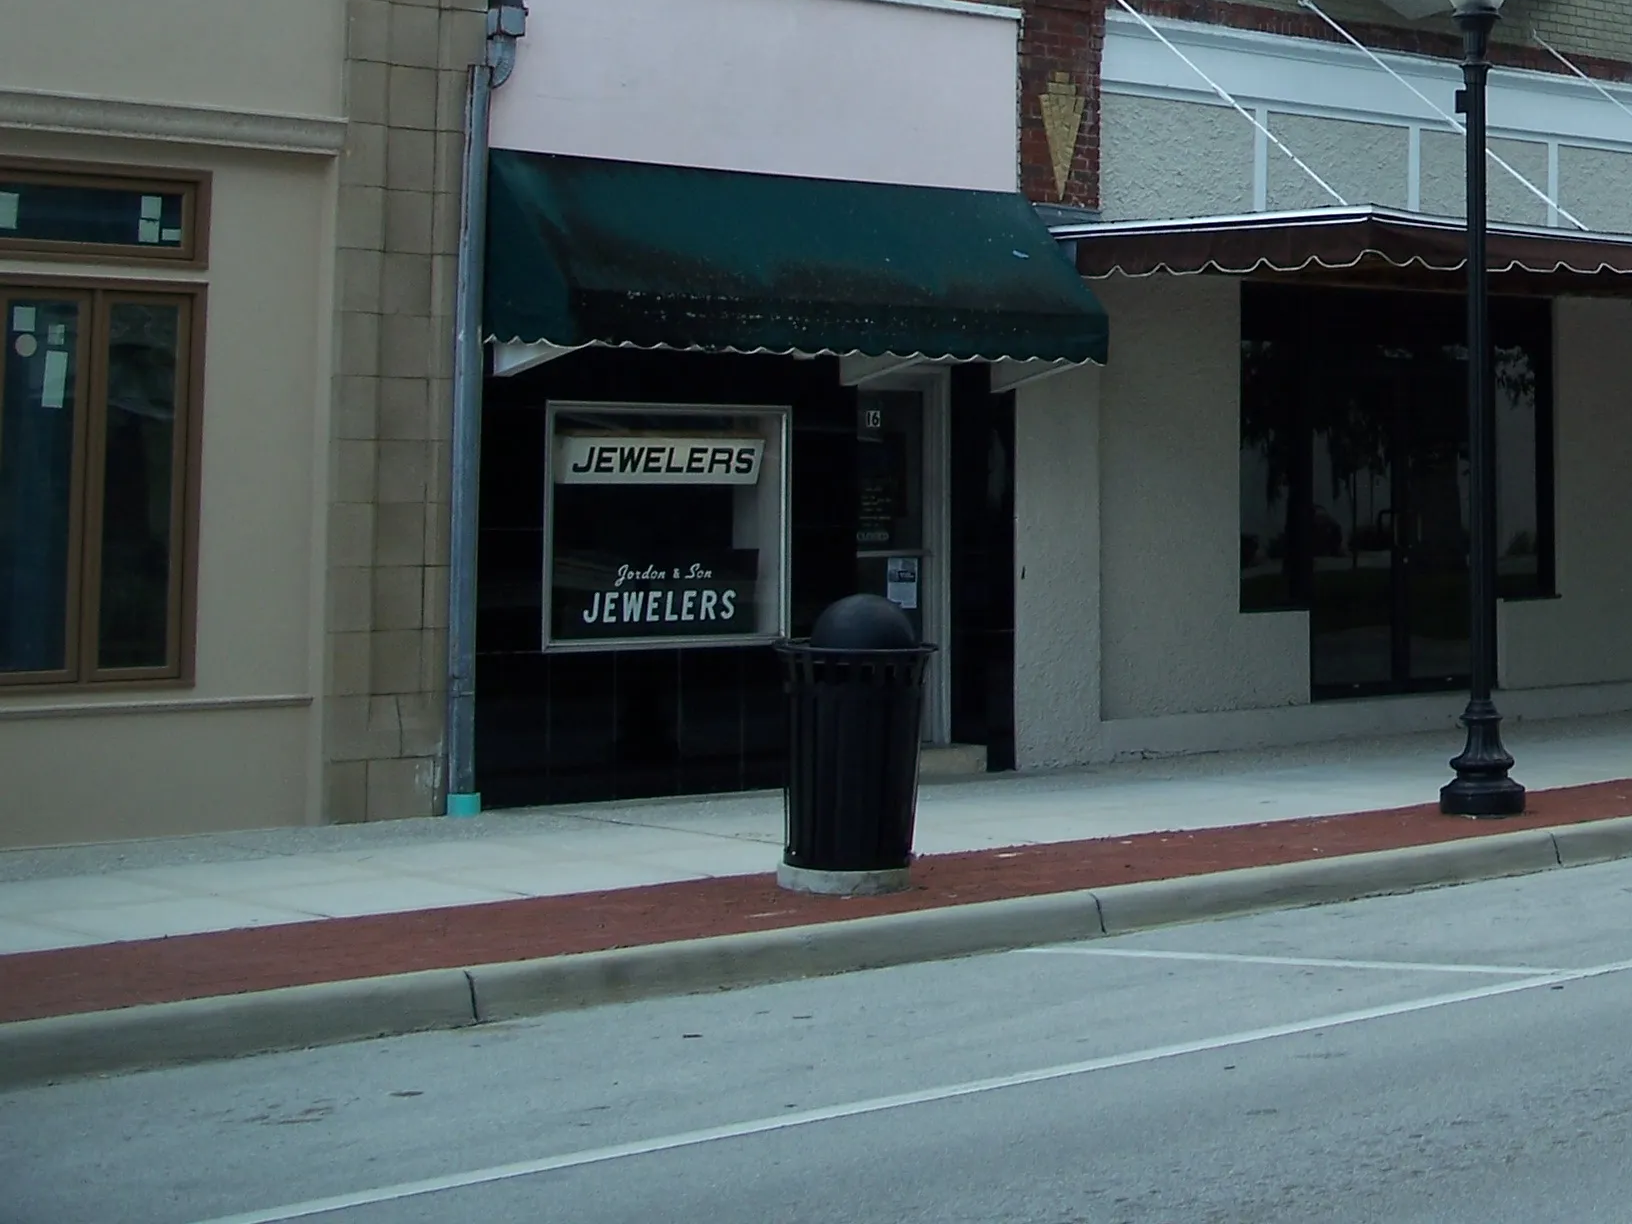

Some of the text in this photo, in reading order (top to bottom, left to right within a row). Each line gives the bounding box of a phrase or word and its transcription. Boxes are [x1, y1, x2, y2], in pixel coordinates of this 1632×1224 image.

[867, 411, 880, 425] 16
[572, 446, 755, 474] JEWELERS
[672, 567, 681, 579] &
[685, 562, 713, 579] Son
[583, 589, 737, 623] JEWELERS
